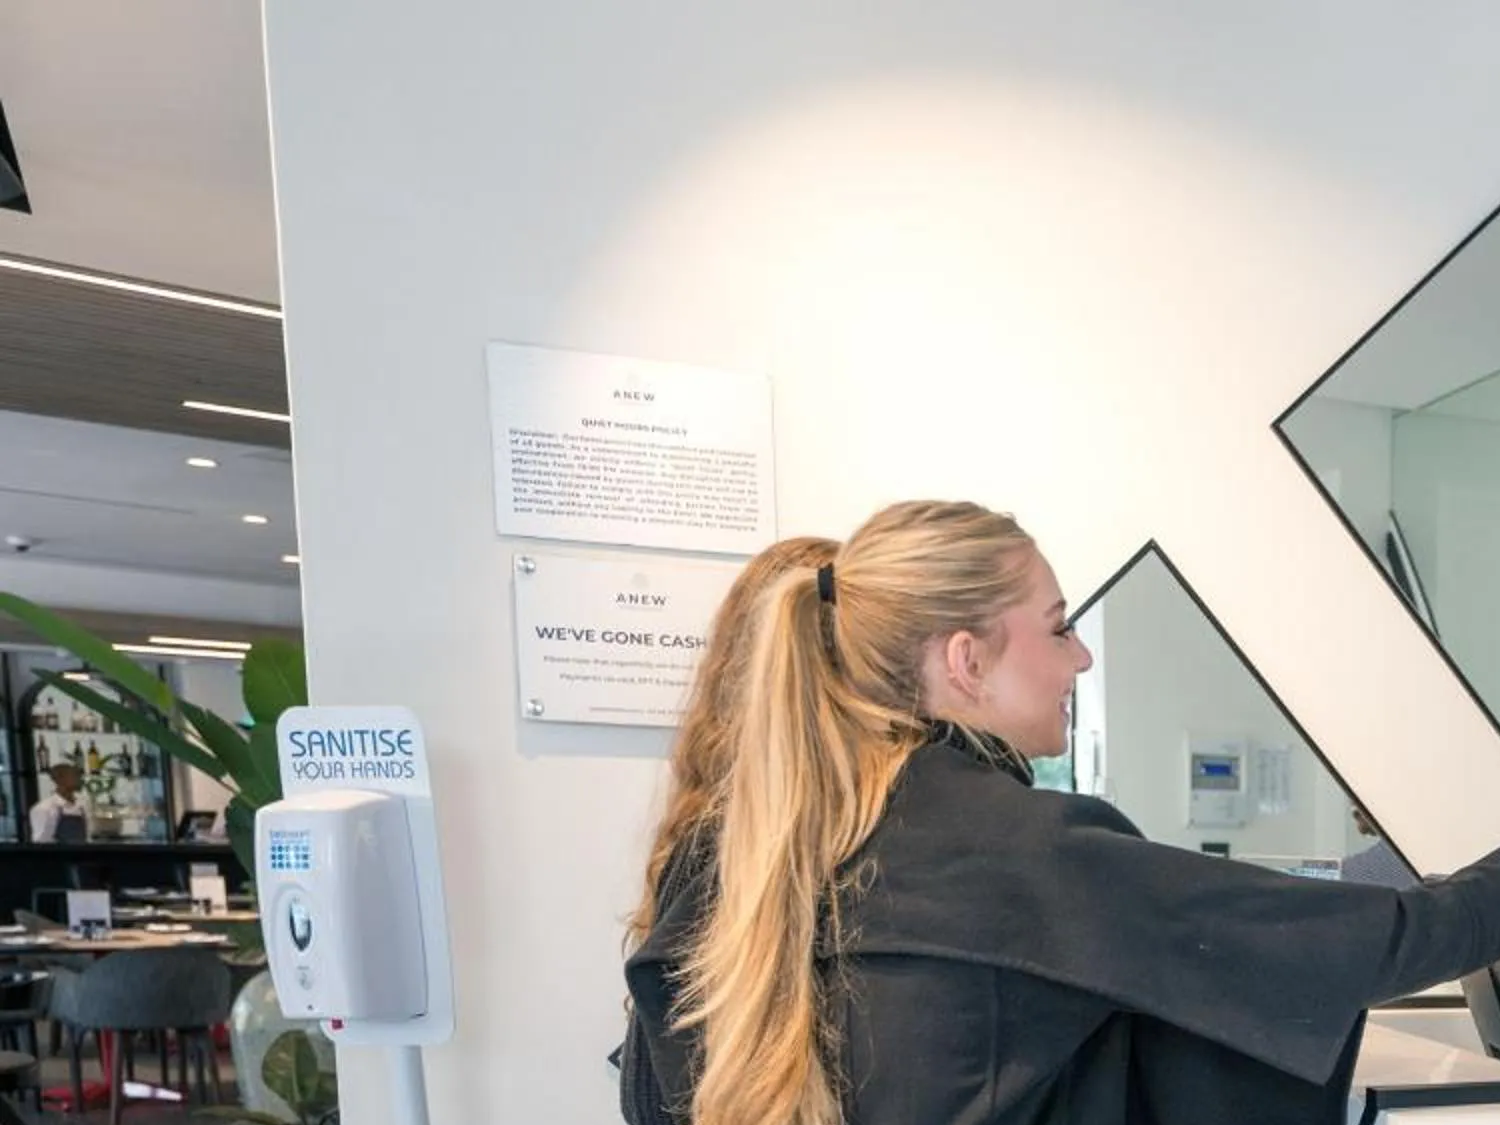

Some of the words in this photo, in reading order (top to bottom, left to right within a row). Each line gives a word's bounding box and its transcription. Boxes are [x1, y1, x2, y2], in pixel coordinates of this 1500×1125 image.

[612, 389, 656, 402] ANEW
[615, 592, 667, 606] ANEW
[535, 625, 596, 644] WE'VE
[600, 629, 655, 647] GONE
[289, 729, 413, 757] SANITISE
[292, 760, 345, 779] YOUR
[350, 759, 416, 779] HANDS
